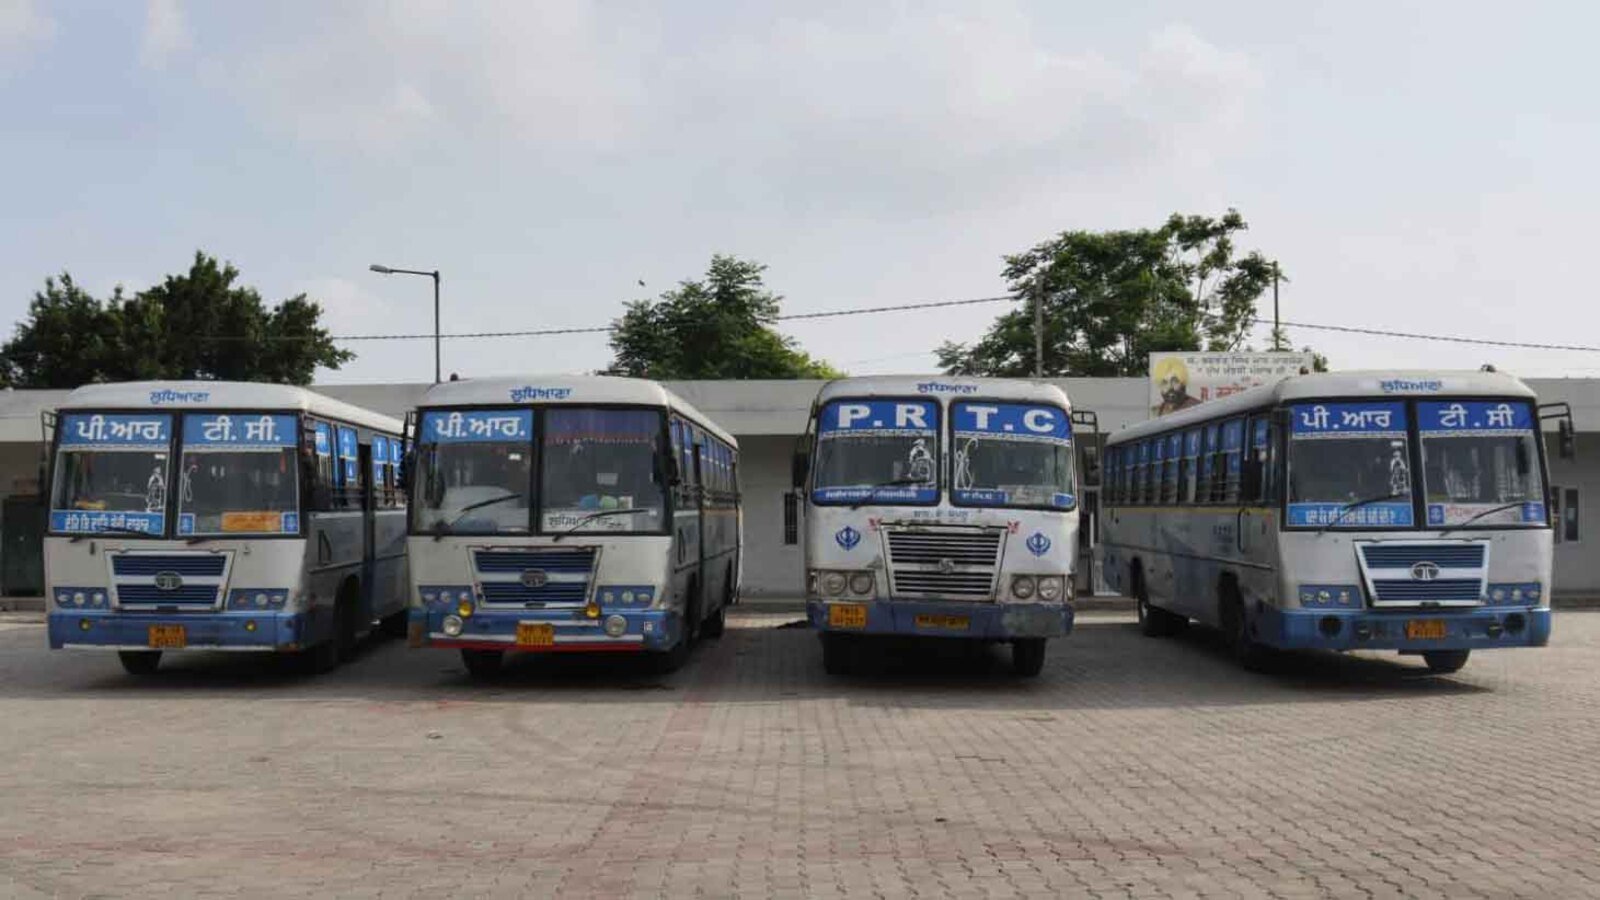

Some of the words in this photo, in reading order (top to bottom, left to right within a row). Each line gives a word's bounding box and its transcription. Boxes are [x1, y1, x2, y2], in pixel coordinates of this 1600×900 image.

[510, 386, 572, 402] ਲੁਧਿਆਣਾ
[1379, 380, 1443, 394] ਲੁਧਿਆਣਾ
[77, 416, 166, 441] ਪੀ.ਆਰ.
[435, 411, 526, 438] ਪੀ.ਆਰ.
